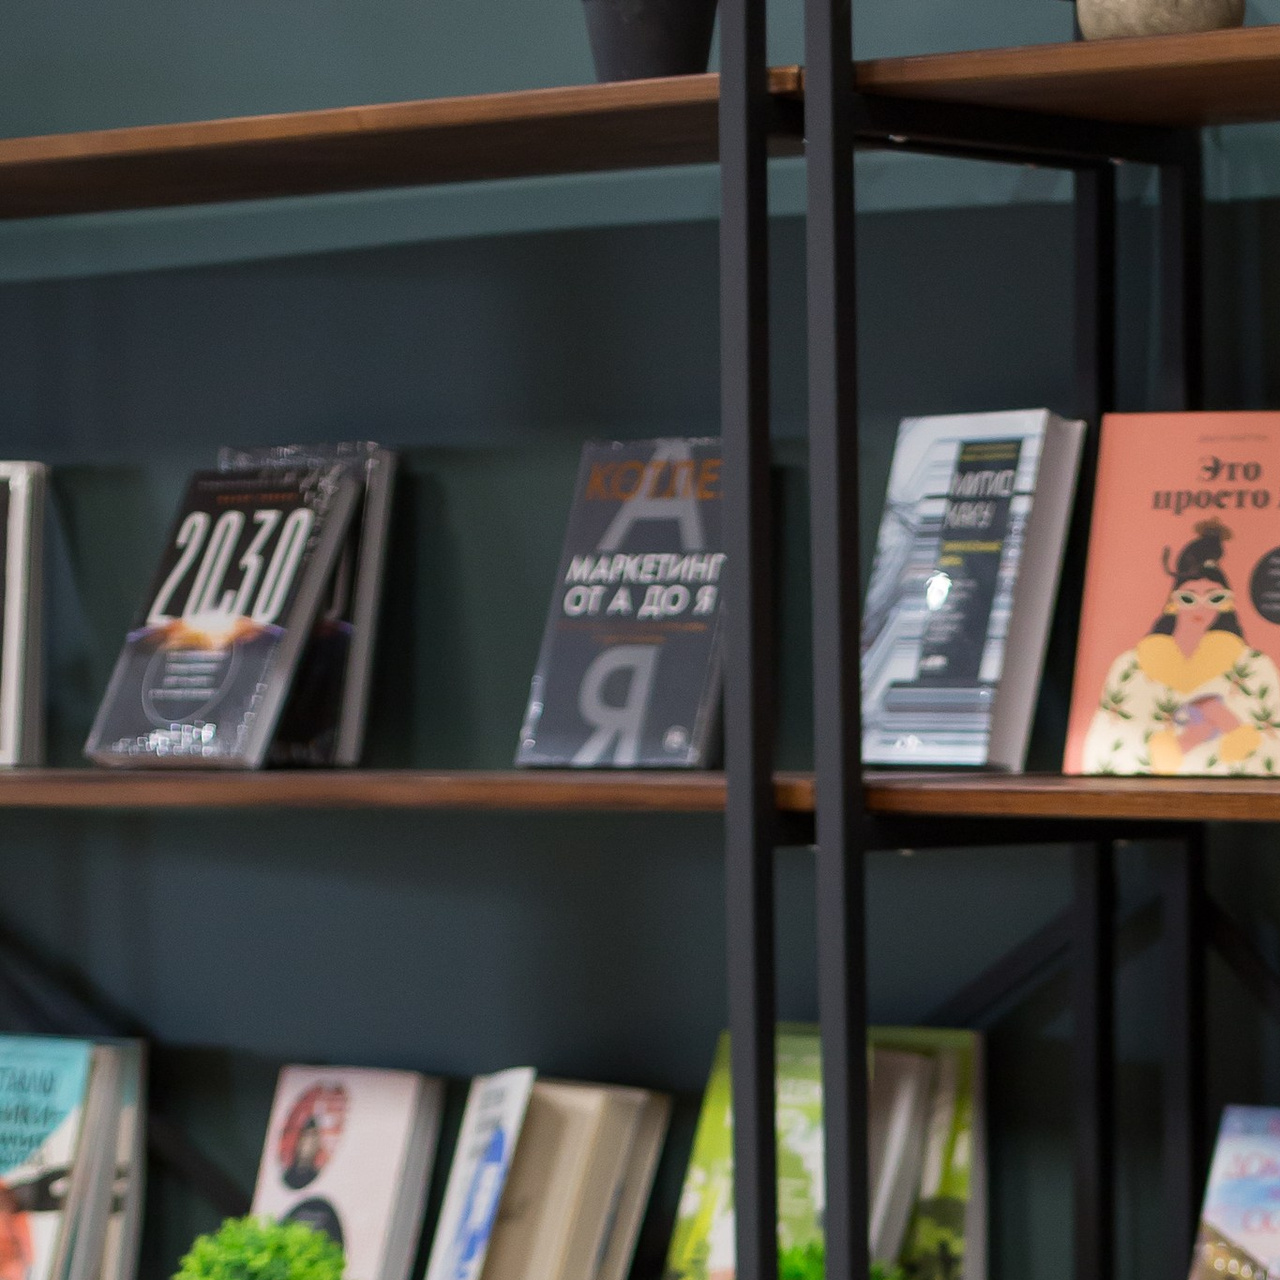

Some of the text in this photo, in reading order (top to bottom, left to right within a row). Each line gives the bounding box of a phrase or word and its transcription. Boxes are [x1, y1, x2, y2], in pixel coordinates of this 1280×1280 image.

[586, 458, 725, 500] КОТЛЕ
[1201, 456, 1261, 482] Это
[1153, 489, 1270, 516] просто
[147, 507, 315, 626] 2030
[564, 552, 728, 585] МАРКЕТИНГ
[563, 584, 718, 620] ОТ А ДО Я
